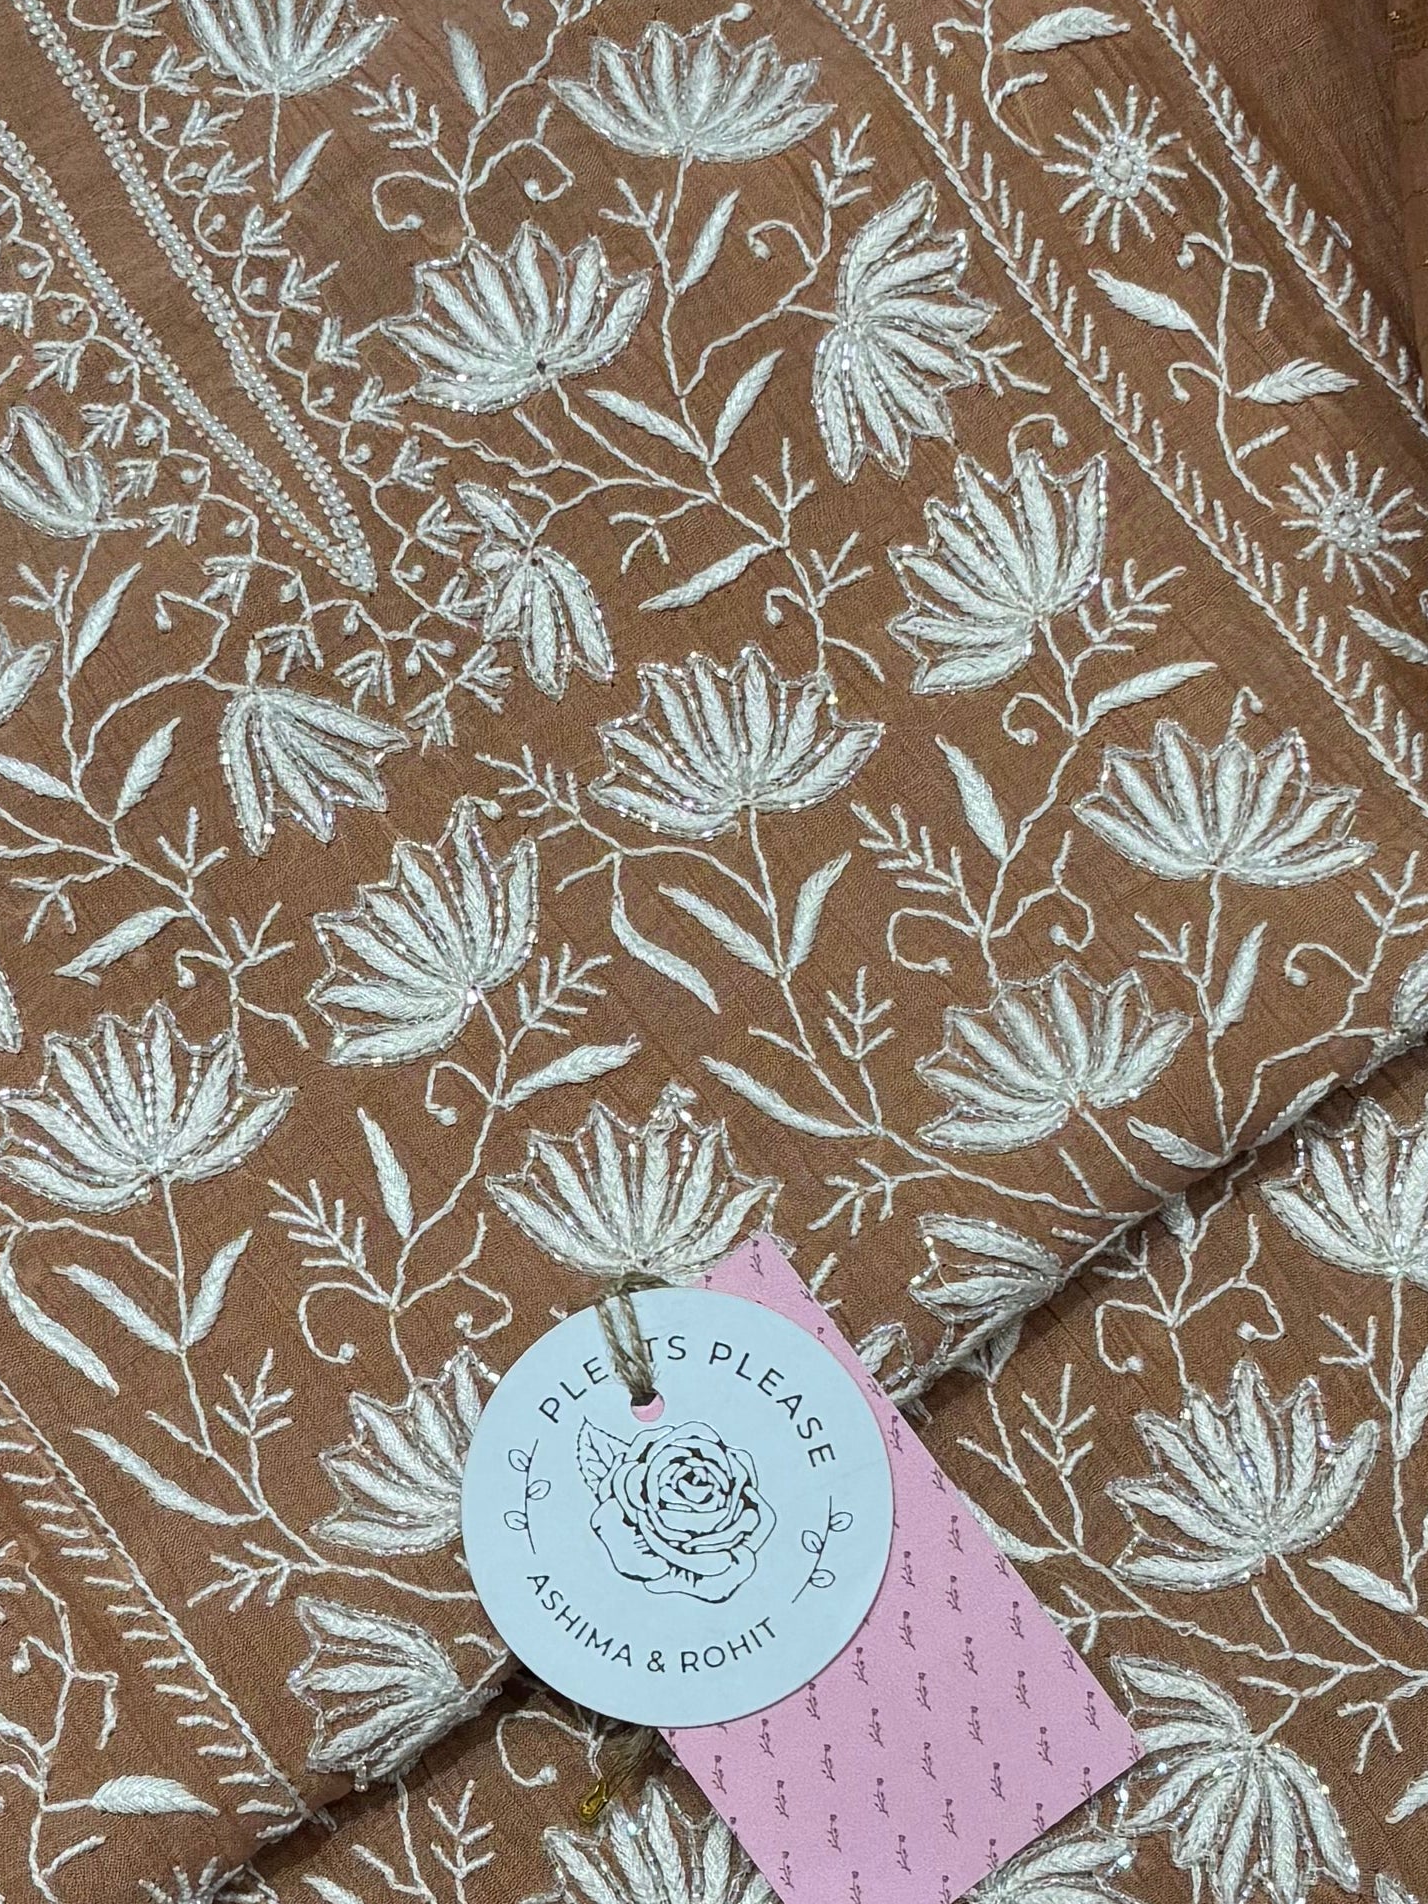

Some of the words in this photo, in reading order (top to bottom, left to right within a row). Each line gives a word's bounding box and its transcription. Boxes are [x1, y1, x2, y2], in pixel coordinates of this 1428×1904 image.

[538, 1335, 687, 1424] PLETS
[708, 1341, 836, 1468] PLEASE
[526, 1574, 632, 1667] ASHIMA
[646, 1650, 666, 1673] &
[680, 1616, 776, 1673] ROHIT
